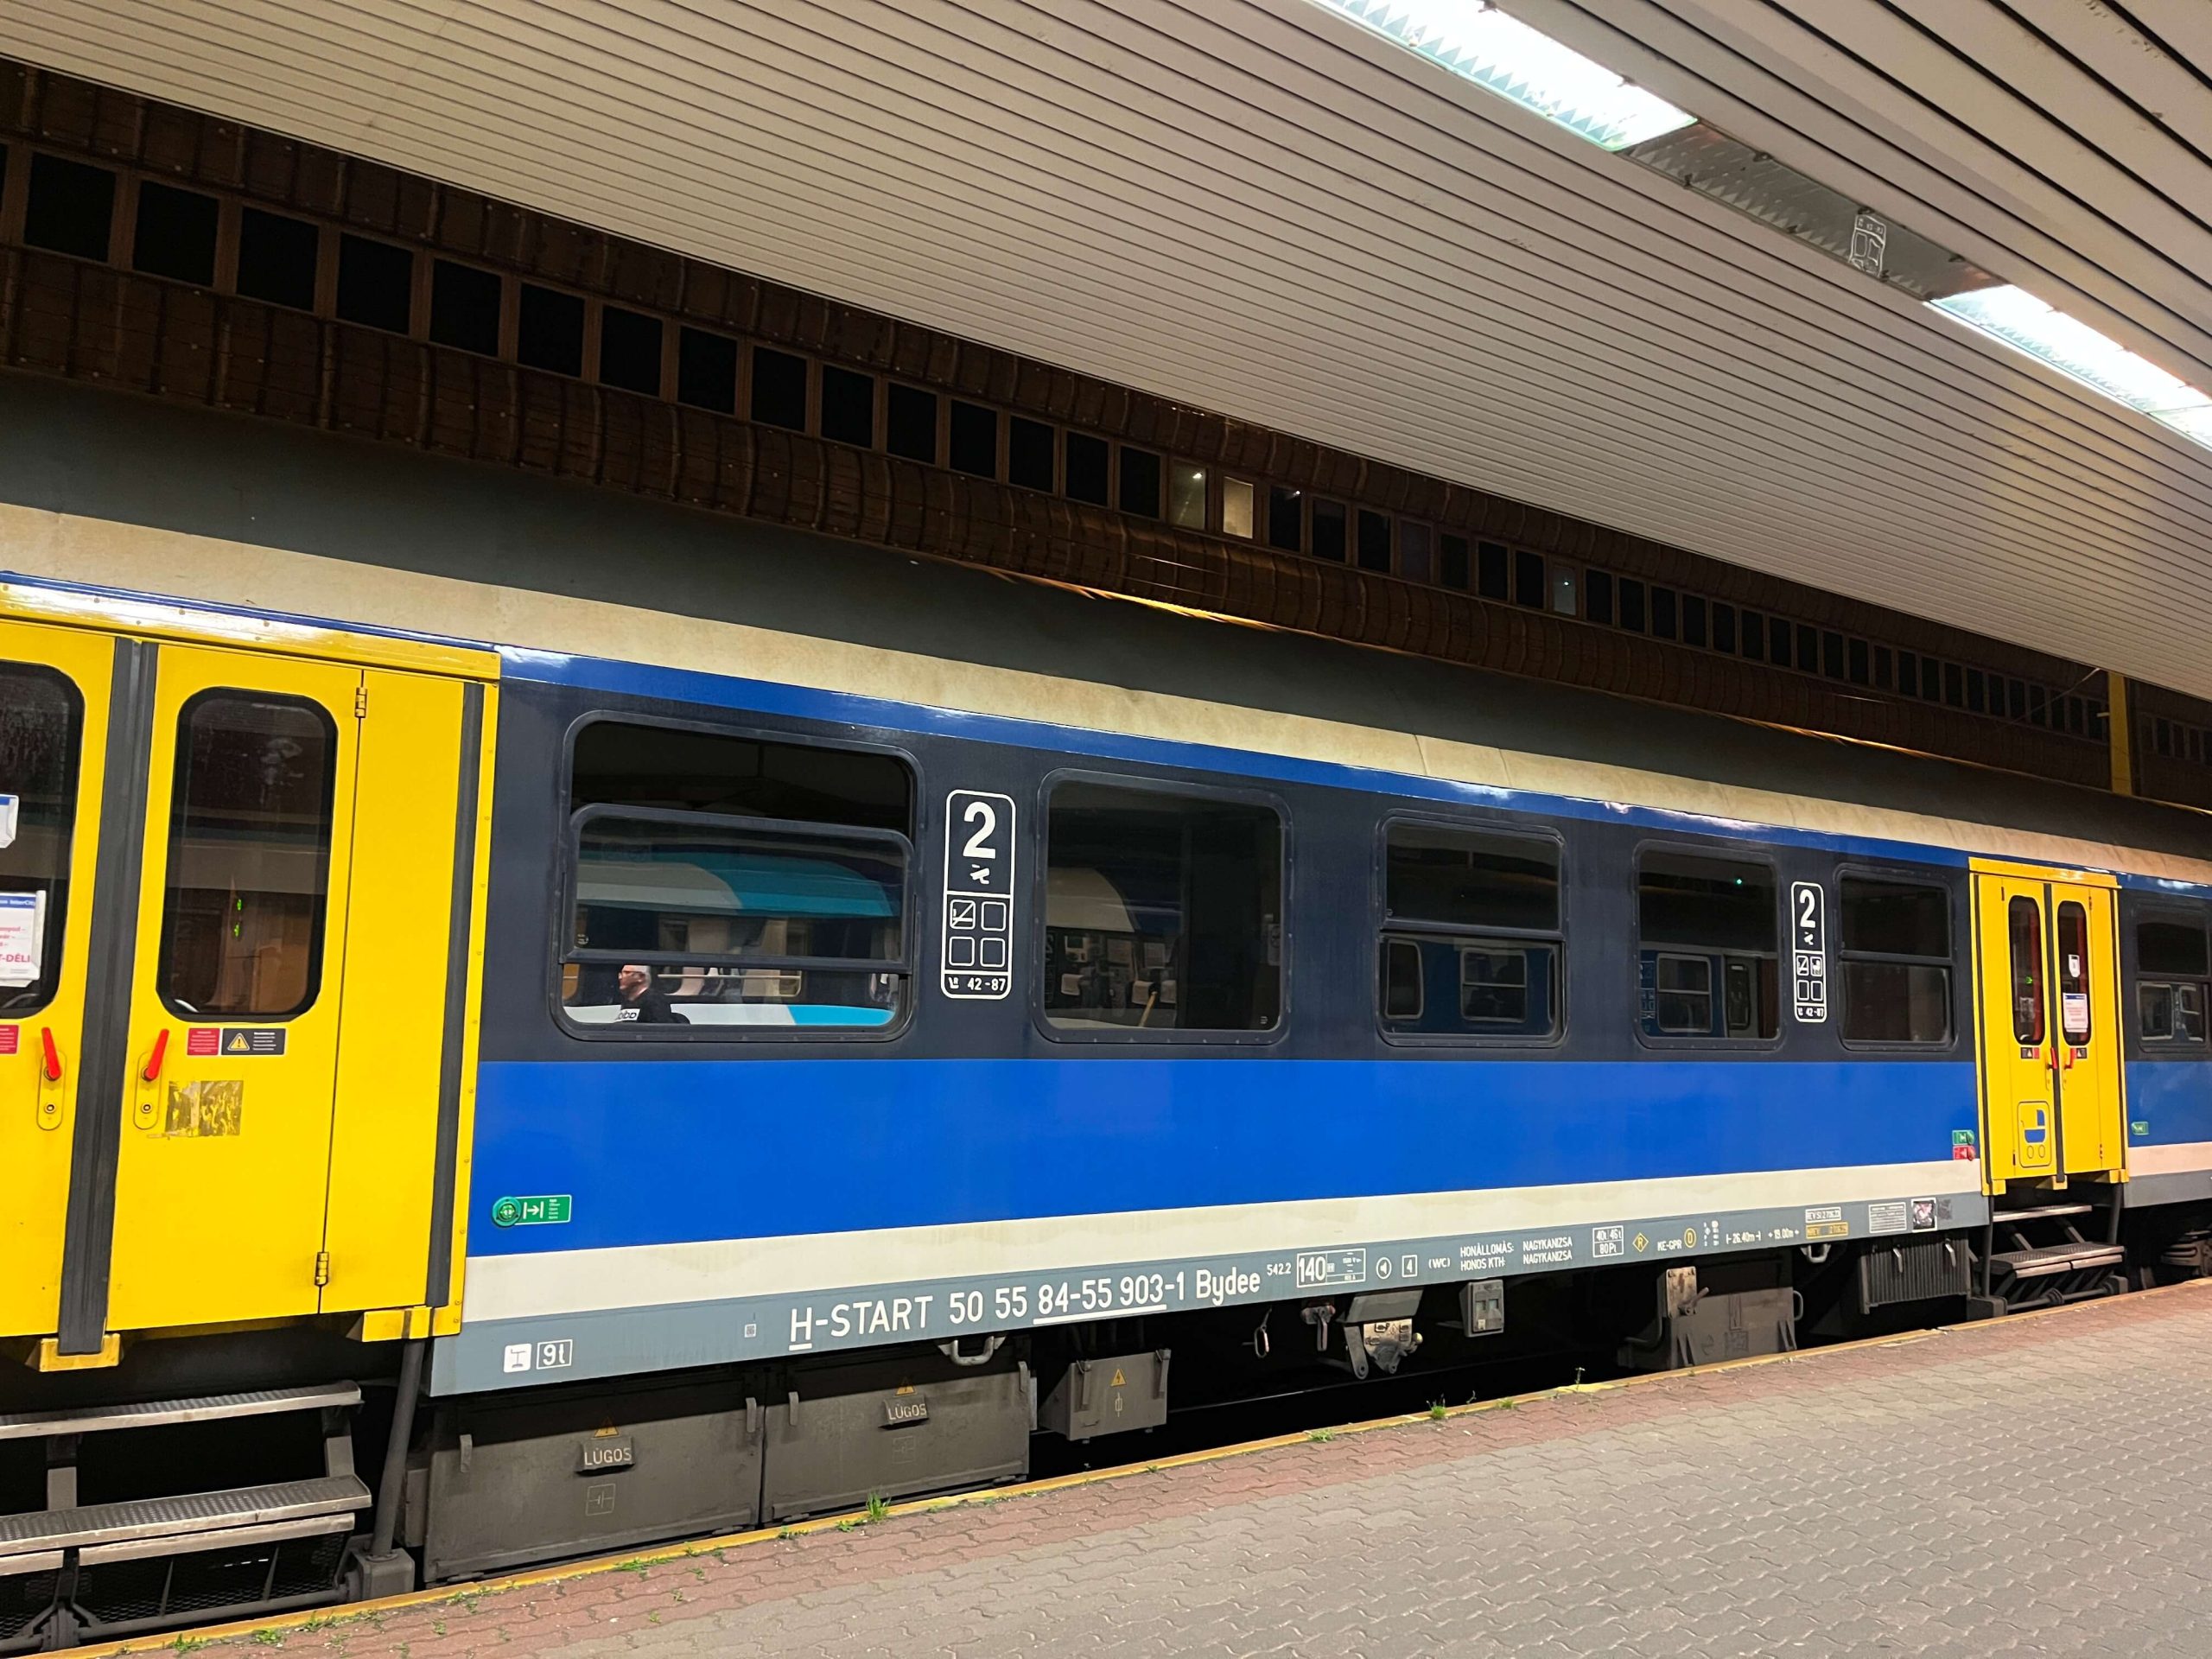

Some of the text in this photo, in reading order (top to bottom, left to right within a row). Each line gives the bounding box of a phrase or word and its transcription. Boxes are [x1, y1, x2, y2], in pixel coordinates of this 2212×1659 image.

[963, 801, 996, 859] 2
[1799, 889, 1816, 928] 2
[967, 977, 1006, 992] 42-87
[1299, 1255, 1326, 1283] 140
[1460, 1258, 1487, 1271] HONOS
[790, 1295, 934, 1345] H-START
[949, 1290, 983, 1325] 50
[995, 1286, 1028, 1319] 55
[1037, 1278, 1112, 1315] 84-55
[1119, 1271, 1185, 1306] 903-1
[1195, 1267, 1261, 1306] Bydee
